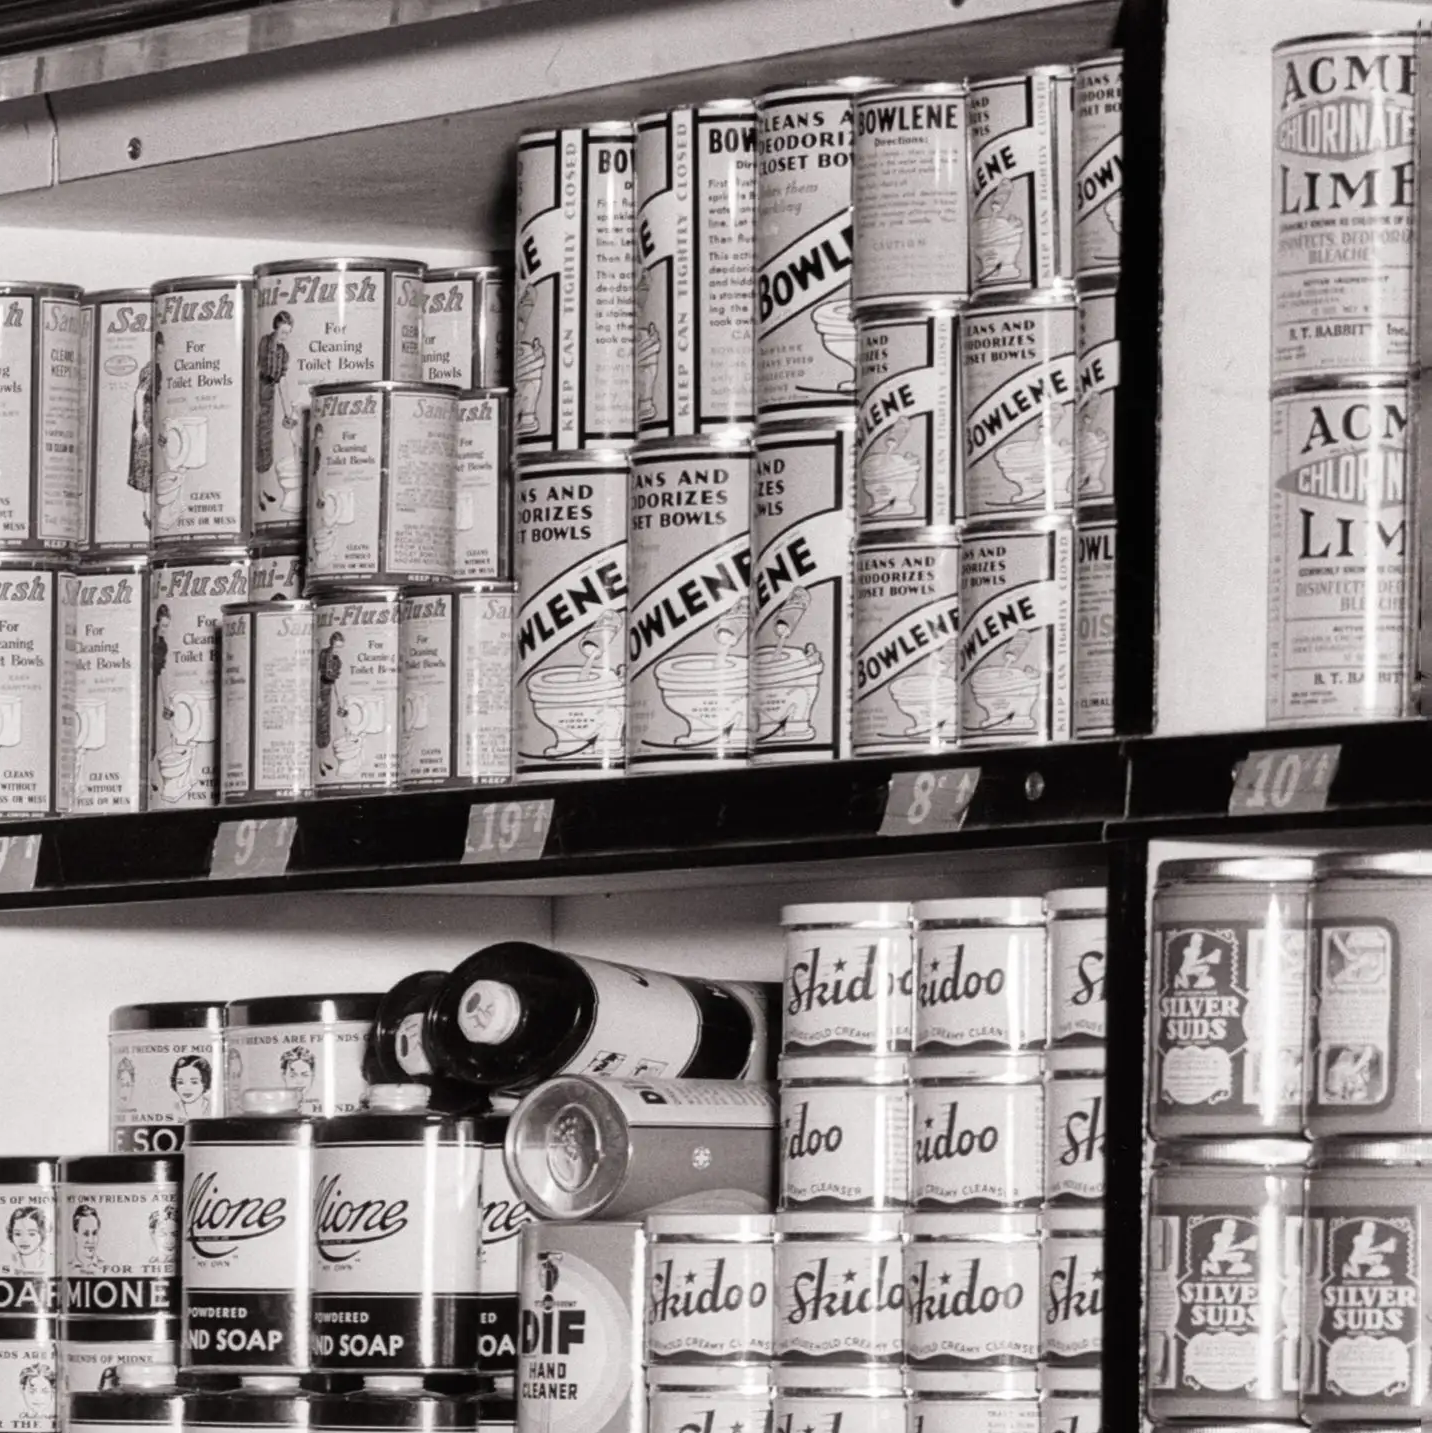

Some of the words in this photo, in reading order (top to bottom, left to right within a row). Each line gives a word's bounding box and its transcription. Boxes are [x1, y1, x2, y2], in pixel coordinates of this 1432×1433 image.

[858, 105, 959, 138] BOWLENE
[565, 140, 576, 218] CLOSED
[561, 329, 575, 368] CAN
[561, 381, 575, 431] KEEP
[544, 484, 594, 504] AND
[545, 524, 591, 542] BOWLS
[103, 1264, 134, 1273] FOR
[141, 1264, 174, 1273] THE
[67, 1281, 170, 1307] MIONE
[1324, 1286, 1415, 1310] SILVER
[521, 1307, 586, 1355] DIF
[1334, 1309, 1402, 1331] SUDS
[528, 1363, 567, 1381] HAND
[523, 1382, 578, 1401] CLEANER
